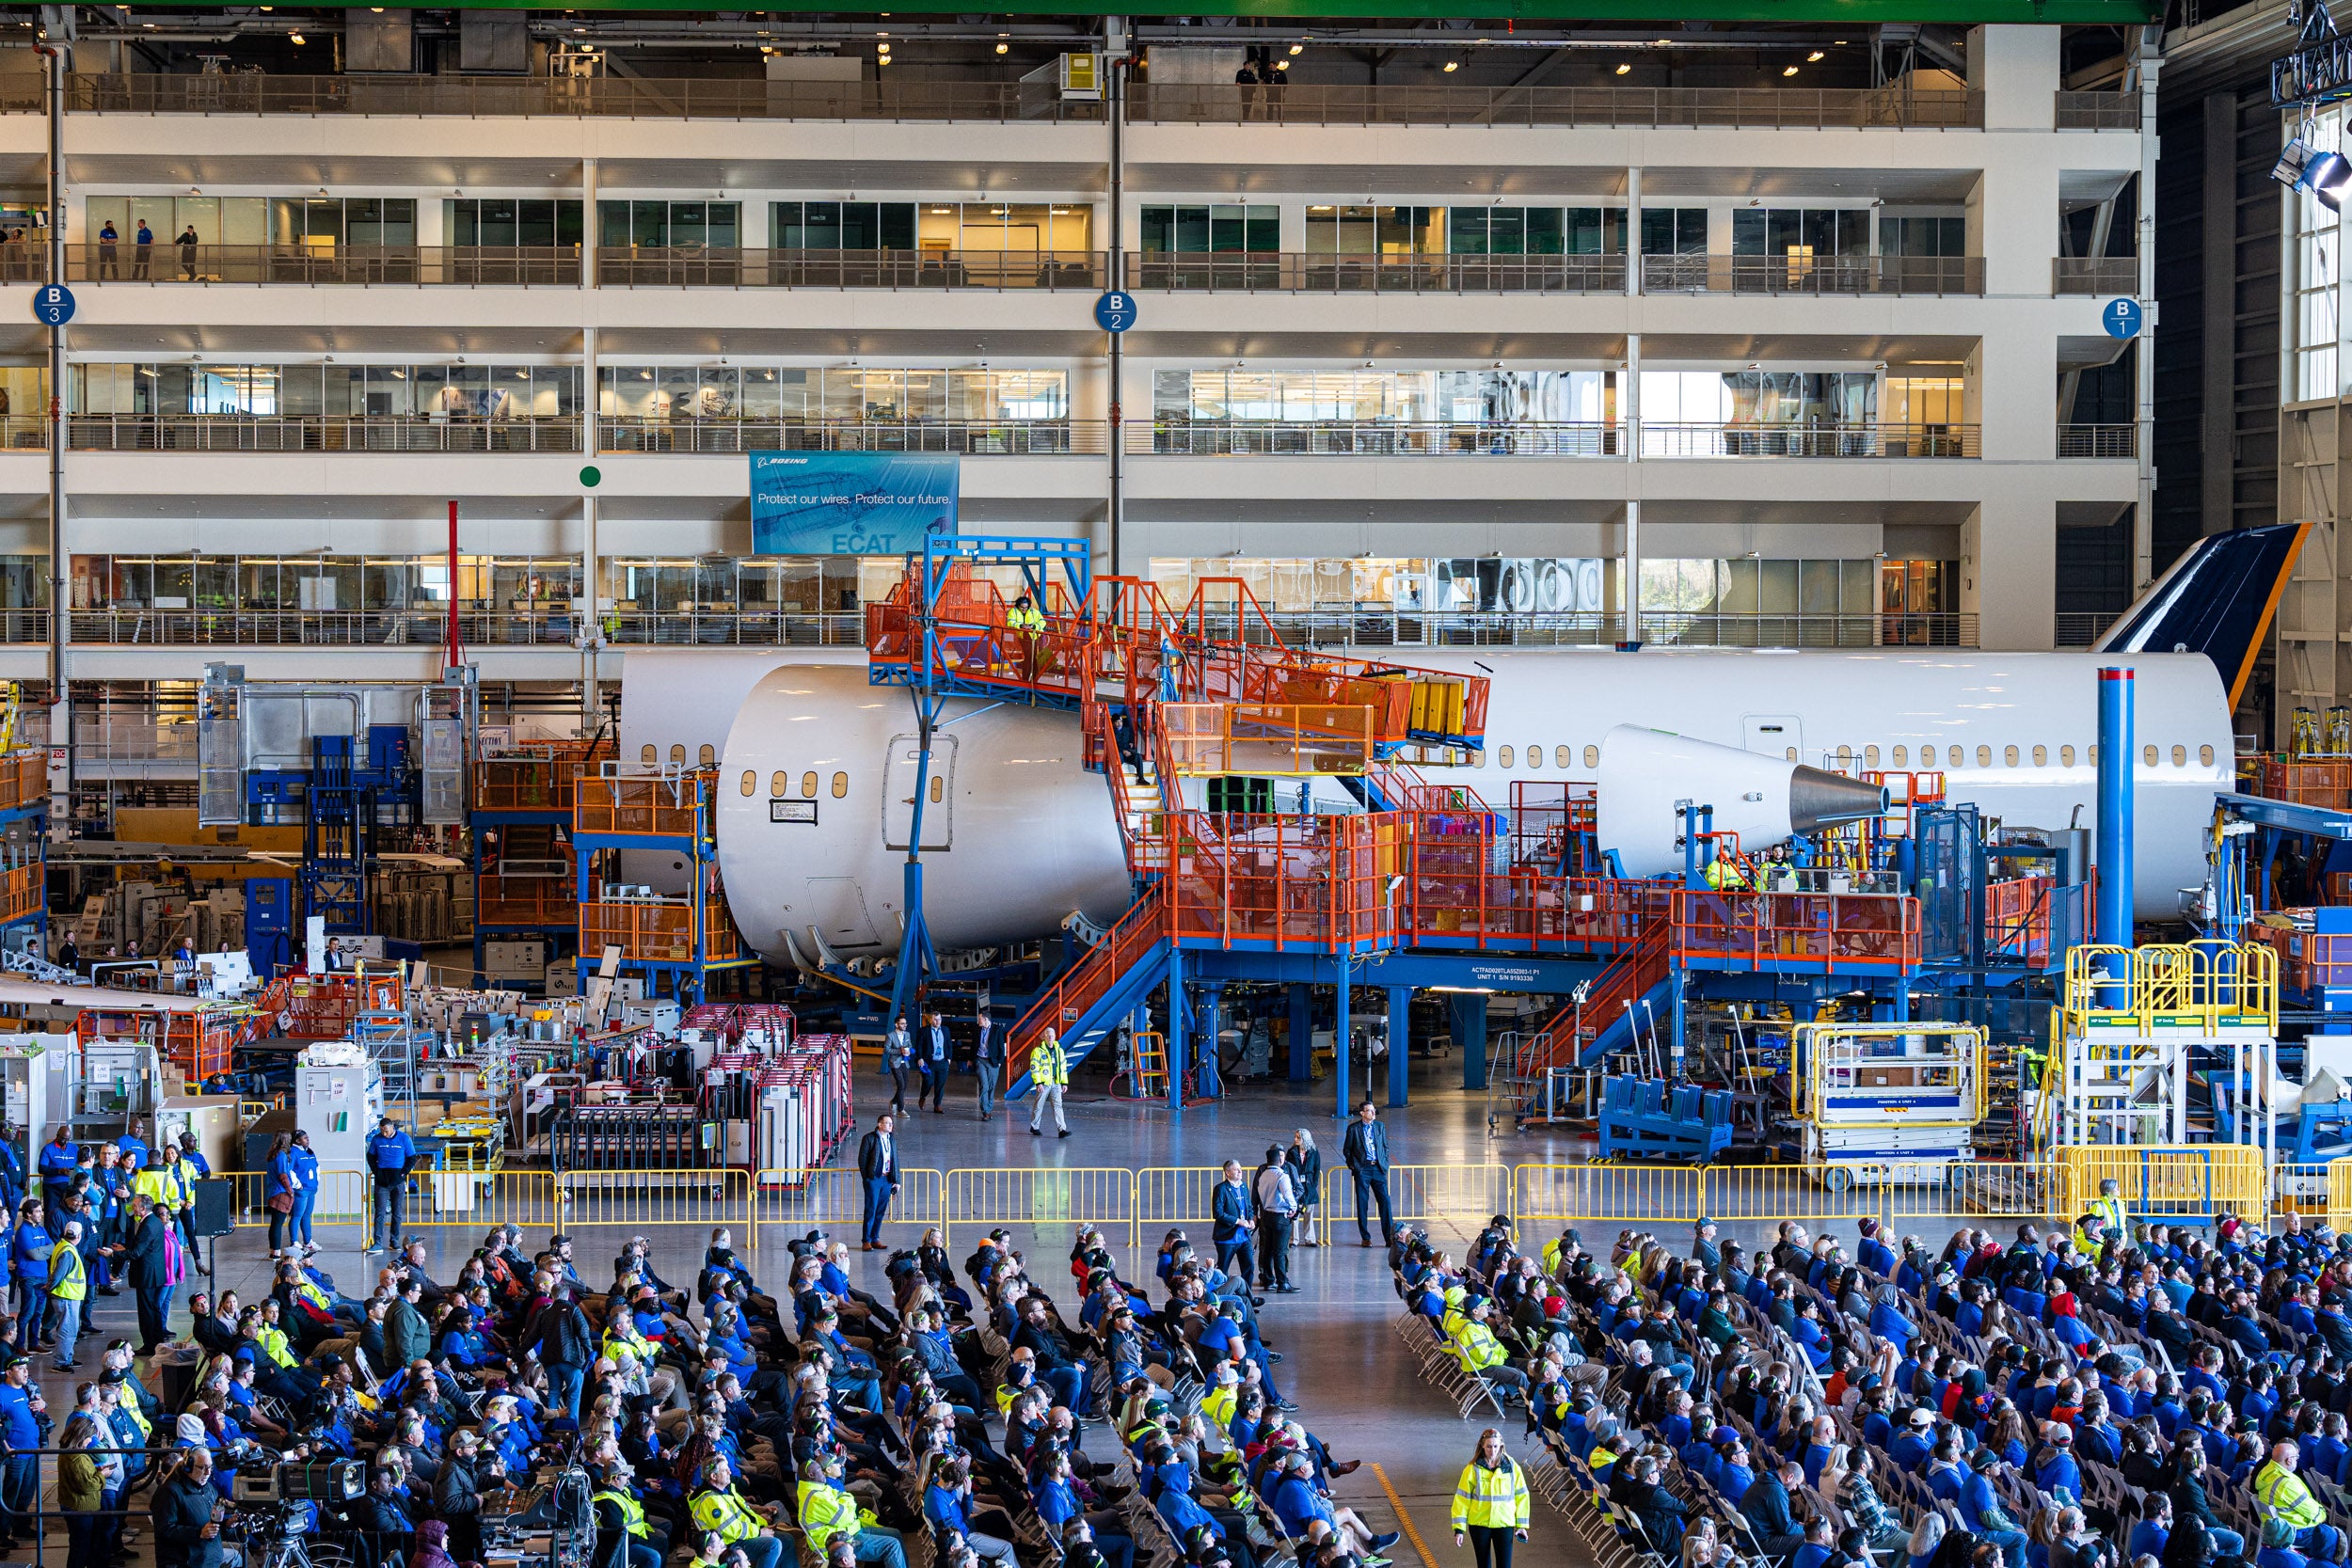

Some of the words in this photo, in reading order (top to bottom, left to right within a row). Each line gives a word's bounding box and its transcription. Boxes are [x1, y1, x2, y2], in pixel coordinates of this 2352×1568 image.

[48, 288, 61, 303] B
[1110, 294, 1123, 309] B
[49, 307, 60, 323] 3
[2116, 301, 2129, 316] B
[1111, 314, 1121, 329] 2
[2119, 320, 2125, 335] 1
[757, 493, 797, 504] Protect
[800, 496, 818, 504] our
[820, 494, 852, 504] wires.
[855, 493, 895, 504] Protect
[897, 496, 915, 504] our
[918, 493, 952, 504] future.
[833, 533, 897, 554] ECAT
